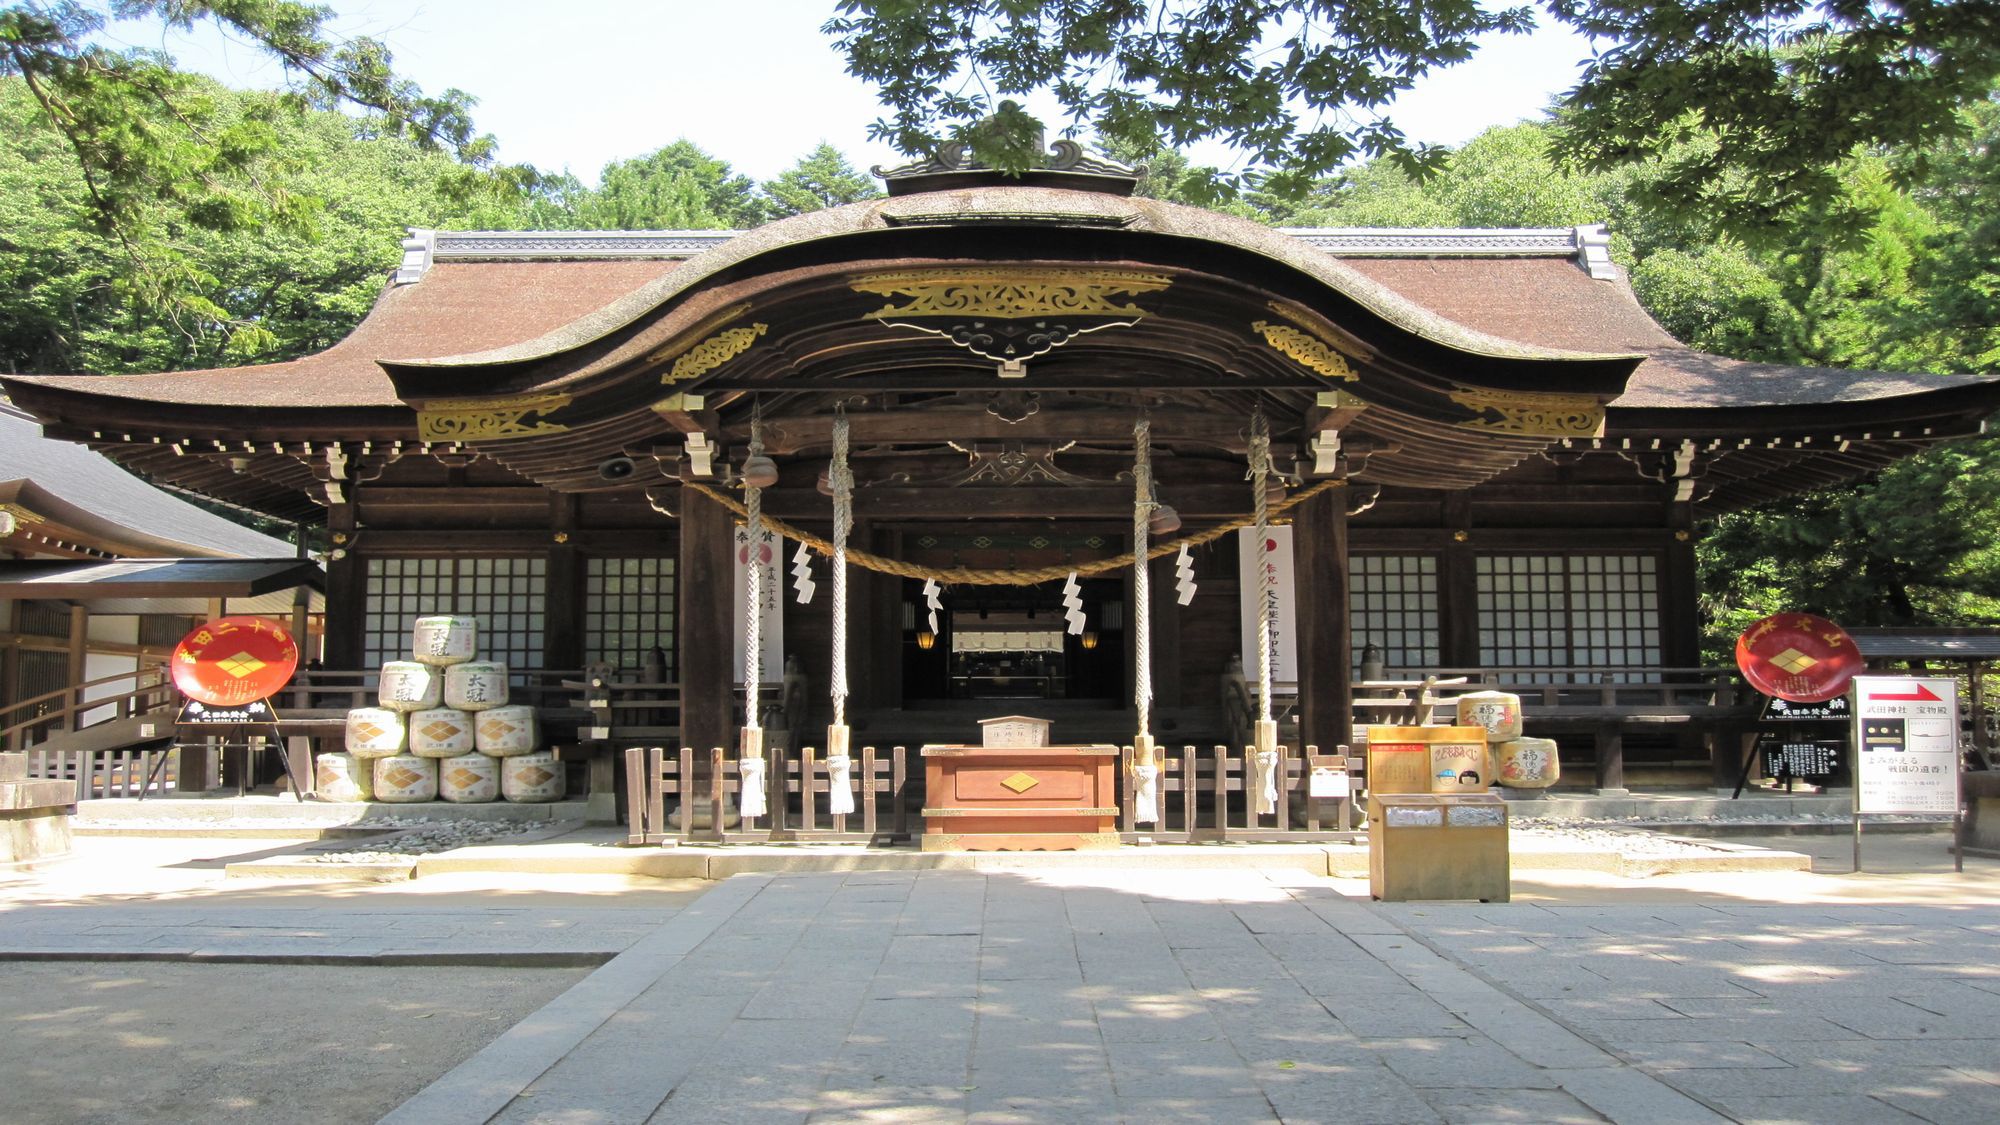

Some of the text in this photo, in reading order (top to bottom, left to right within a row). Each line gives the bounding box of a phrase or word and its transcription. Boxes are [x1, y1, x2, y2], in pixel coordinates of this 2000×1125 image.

[766, 566, 777, 611] 平成二十五年
[1867, 705, 1948, 715] 武田神社 宝物殿
[1868, 756, 1919, 765] よみがえる
